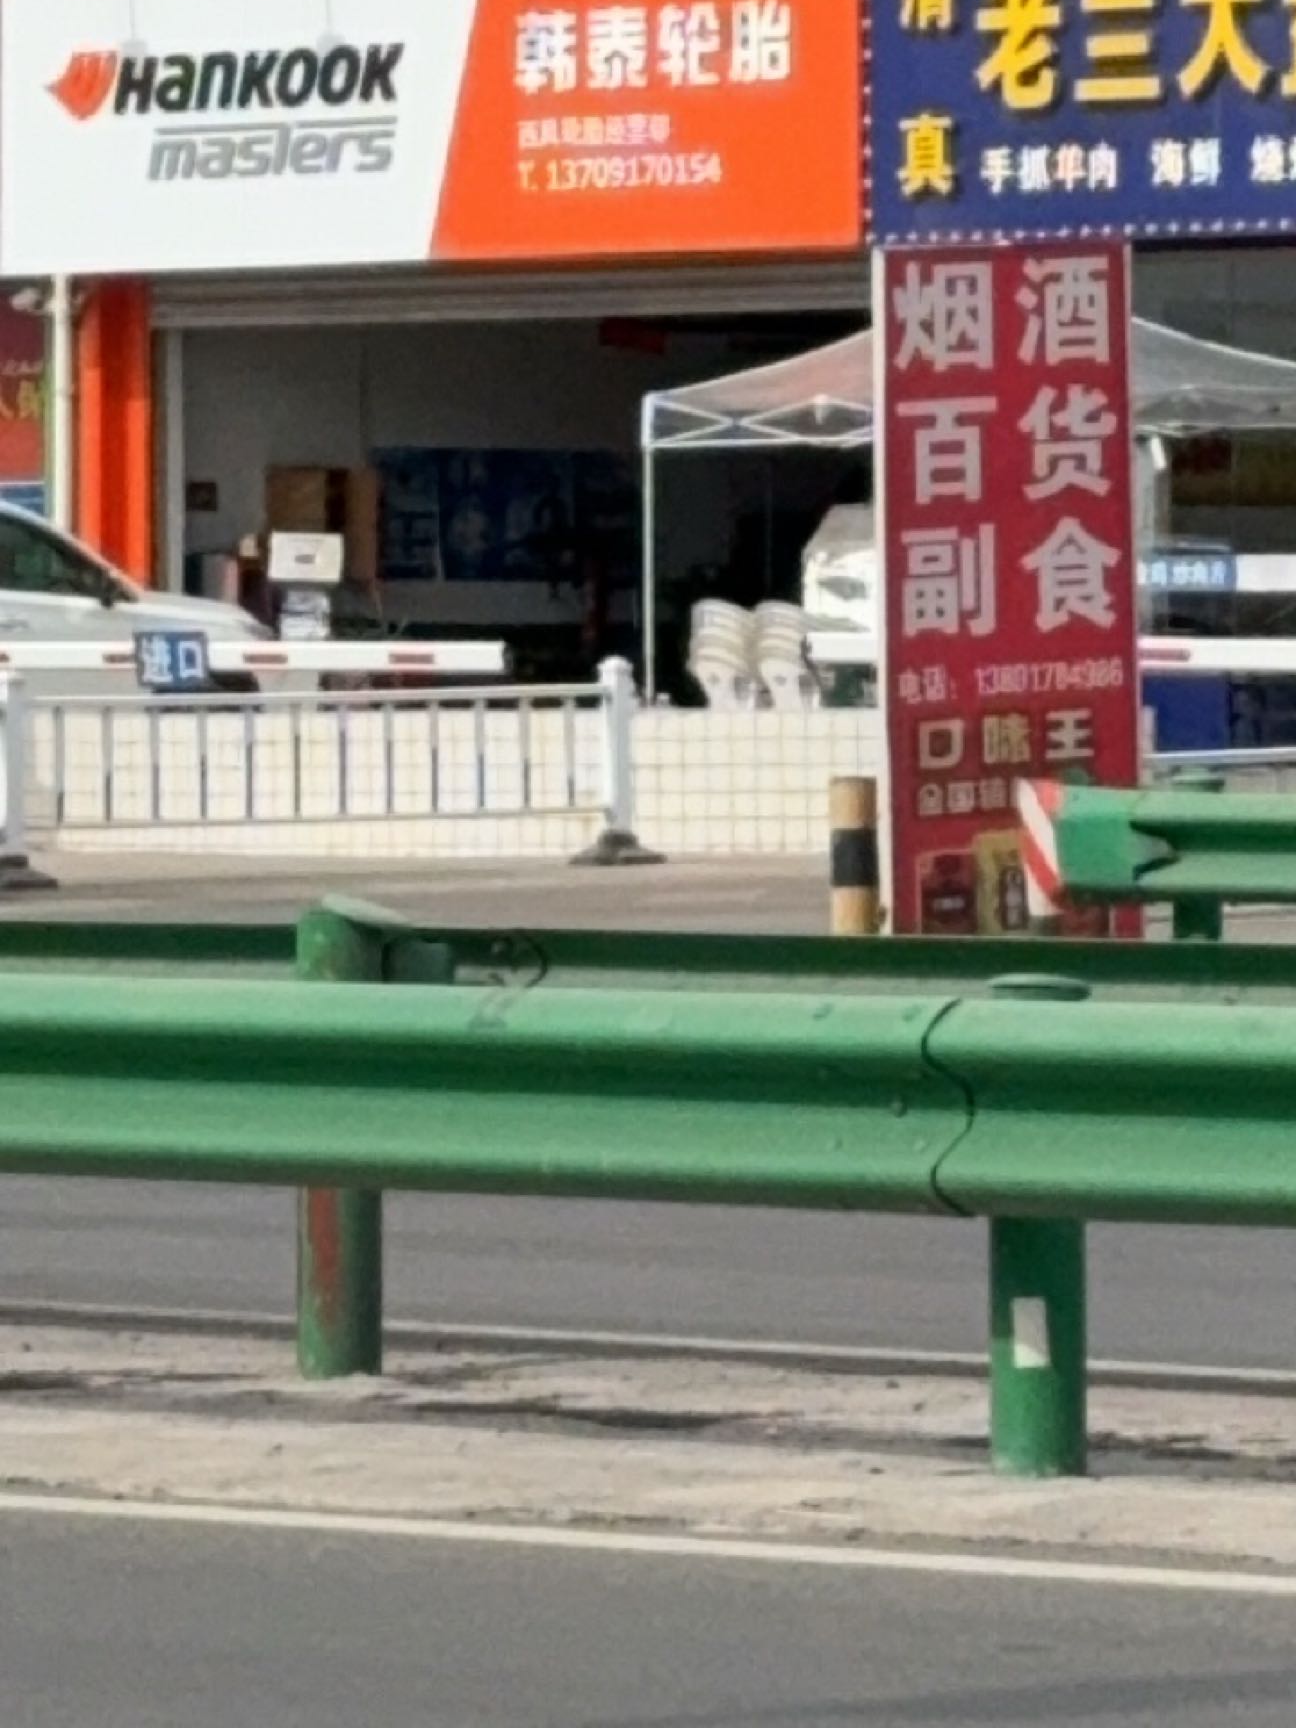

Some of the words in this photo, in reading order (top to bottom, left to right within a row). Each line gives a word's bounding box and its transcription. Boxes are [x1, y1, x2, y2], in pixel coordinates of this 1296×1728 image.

[514, 0, 792, 93] 韩泰轮胎
[148, 118, 398, 182] masters
[979, 139, 1118, 194] 手抓羊肉
[1151, 137, 1222, 188] 海鲜
[892, 256, 1112, 373] 烟酒
[895, 384, 1118, 504] 百货
[899, 517, 1122, 638] 副食
[138, 634, 204, 687] 进口
[918, 708, 1095, 770] 口味王
